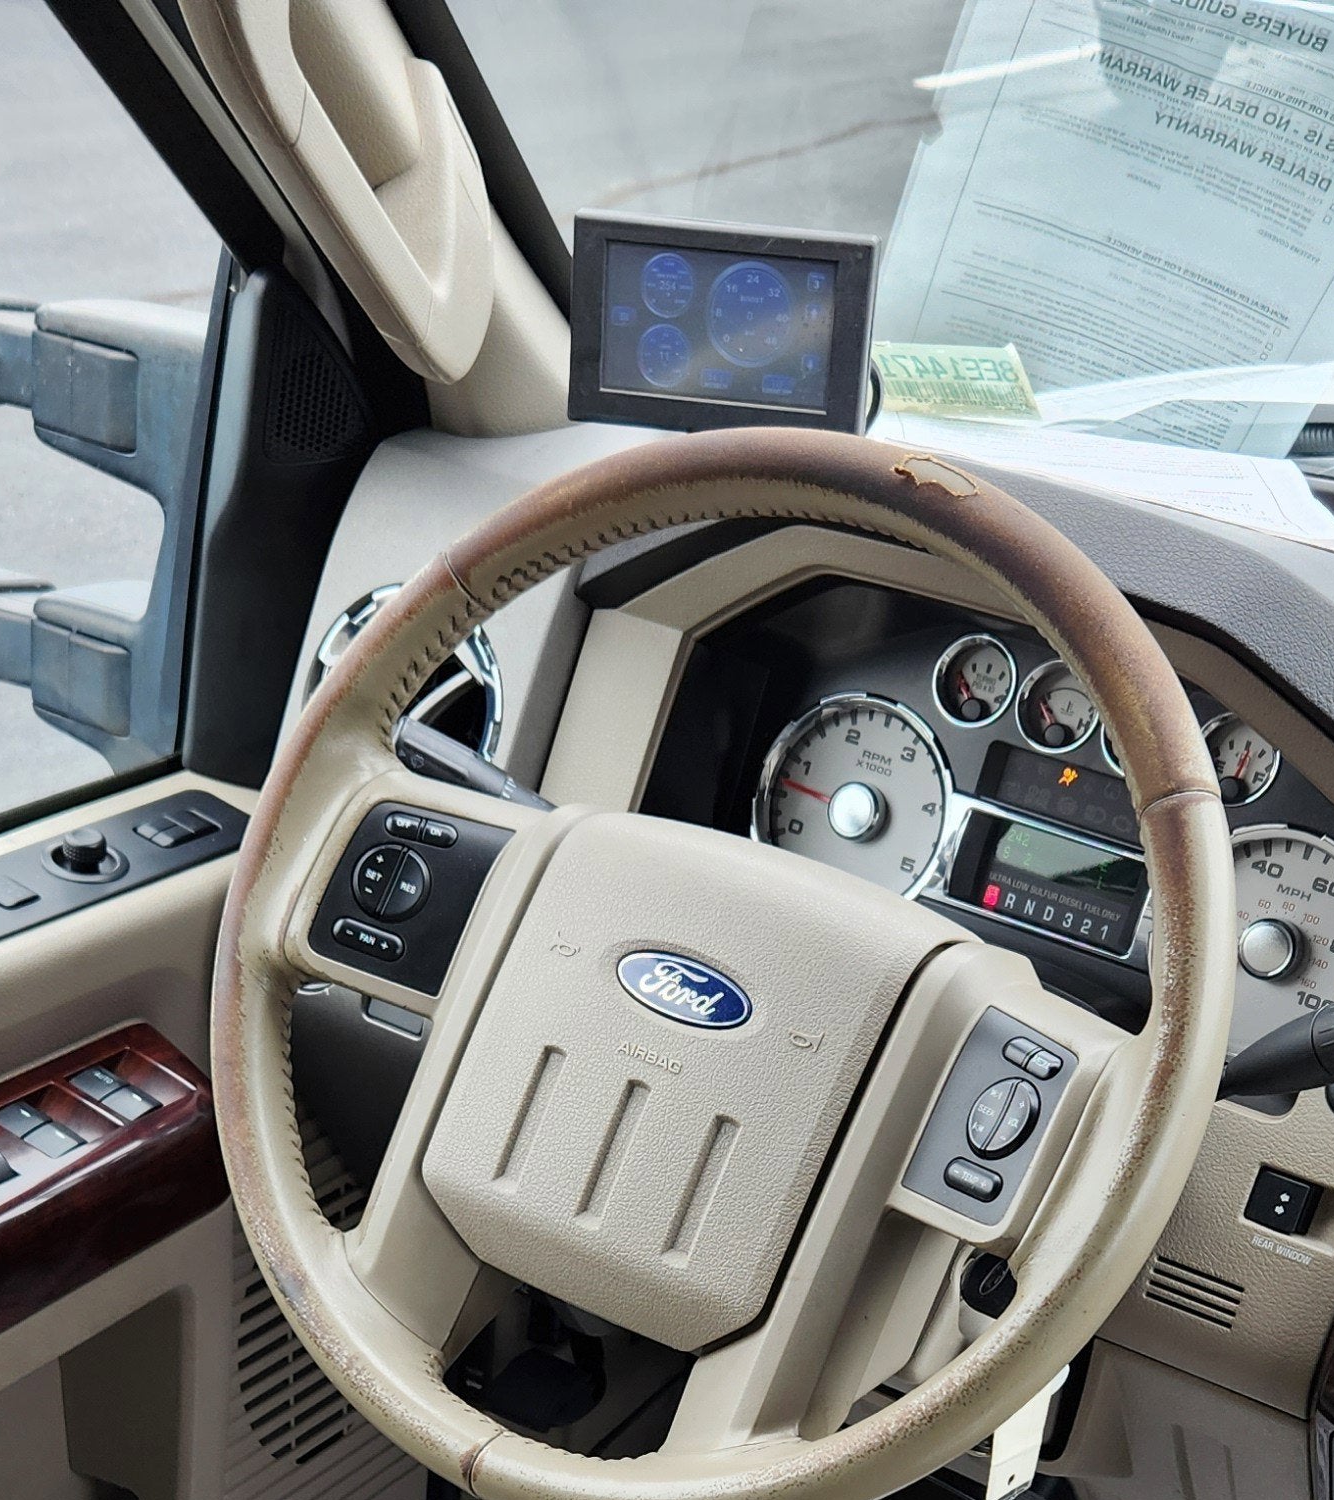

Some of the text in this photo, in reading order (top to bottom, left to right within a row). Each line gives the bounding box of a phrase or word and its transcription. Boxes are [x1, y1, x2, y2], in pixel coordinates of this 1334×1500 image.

[747, 274, 760, 284] 24
[726, 285, 738, 294] 16
[767, 288, 781, 298] 32
[845, 729, 861, 745] 2
[862, 750, 892, 766] RPM
[900, 746, 916, 763] 3
[803, 761, 811, 775] 1
[856, 760, 892, 777] X1000
[1252, 771, 1265, 784] F
[921, 802, 936, 817] 4
[396, 819, 413, 829] OFF
[788, 819, 803, 834] 0
[429, 828, 443, 838] ON
[900, 857, 915, 873] 5
[1251, 860, 1284, 880] 40
[365, 869, 383, 882] SET
[400, 880, 417, 895] RES
[1276, 883, 1312, 902] MPH
[989, 872, 1121, 921] ULTRA LOW SULFUR DIESEL FUEL ONLY
[1258, 900, 1271, 910] 60
[1282, 901, 1296, 912] 80
[1005, 893, 1016, 909] R
[1024, 900, 1036, 916] N
[1043, 906, 1054, 922] D
[1062, 913, 1073, 928] 3
[1080, 919, 1091, 935] 2
[1101, 925, 1109, 940] 1
[1302, 912, 1320, 925] 100
[359, 931, 376, 946] FAN
[1311, 936, 1329, 947] 120
[1310, 959, 1329, 970] 140
[638, 961, 724, 1017] Ford
[1299, 978, 1317, 989] 160
[617, 1041, 683, 1075] AIRBAG
[1252, 1236, 1312, 1266] REAR WINDOW
